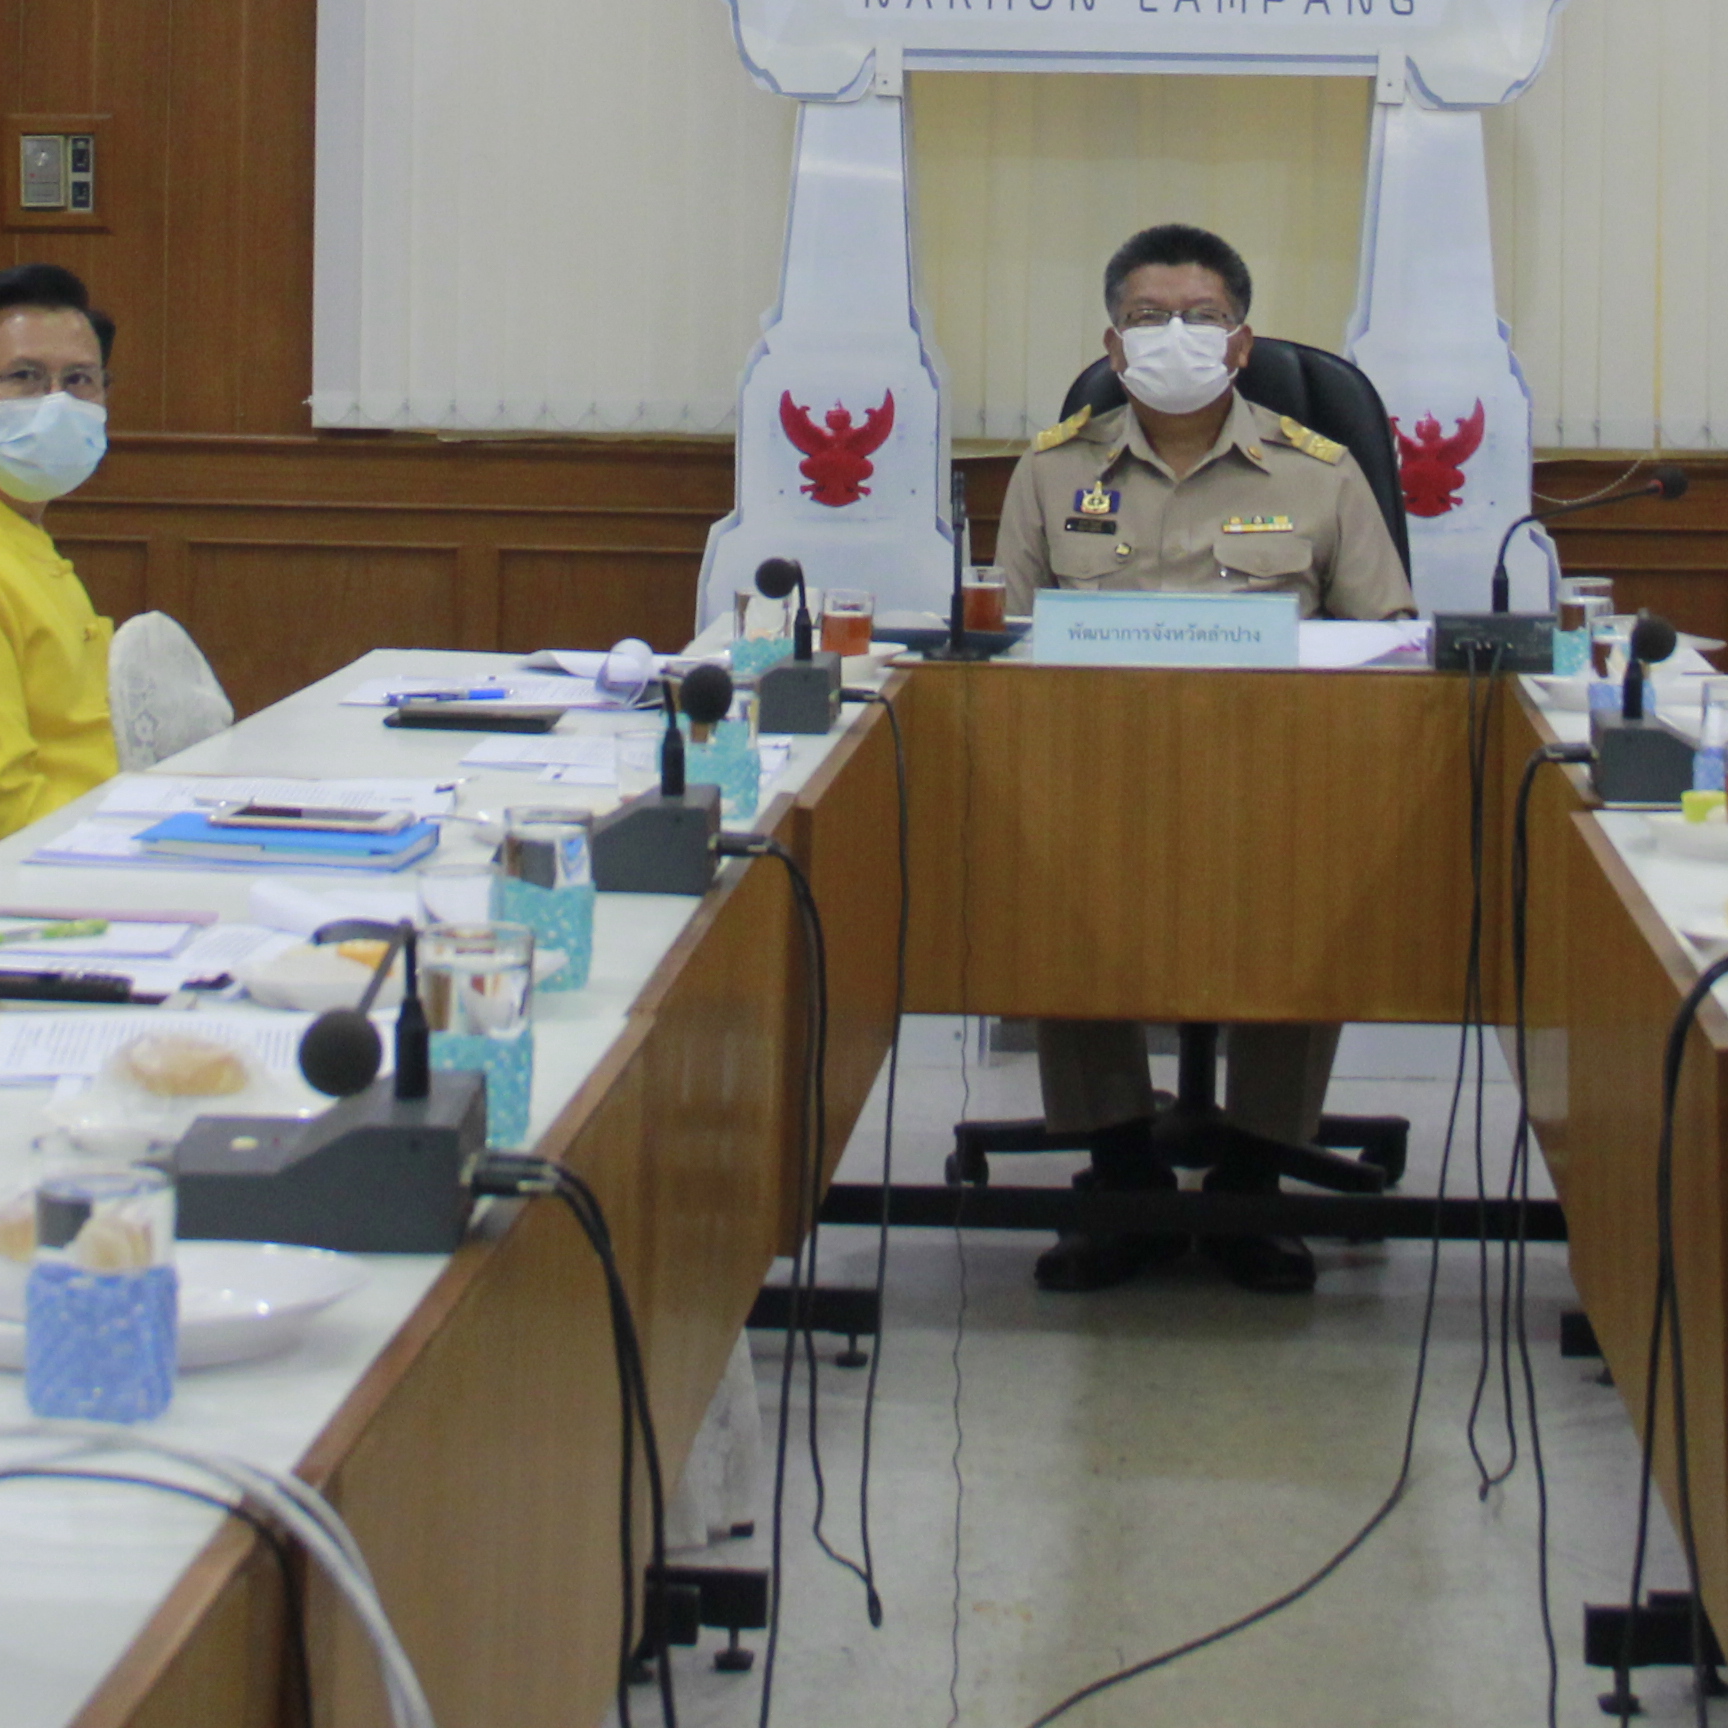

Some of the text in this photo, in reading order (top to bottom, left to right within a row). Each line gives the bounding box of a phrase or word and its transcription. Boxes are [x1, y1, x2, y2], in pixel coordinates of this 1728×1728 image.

[1067, 622, 1263, 644] พัฒนาการจังหวัดลำปาง
